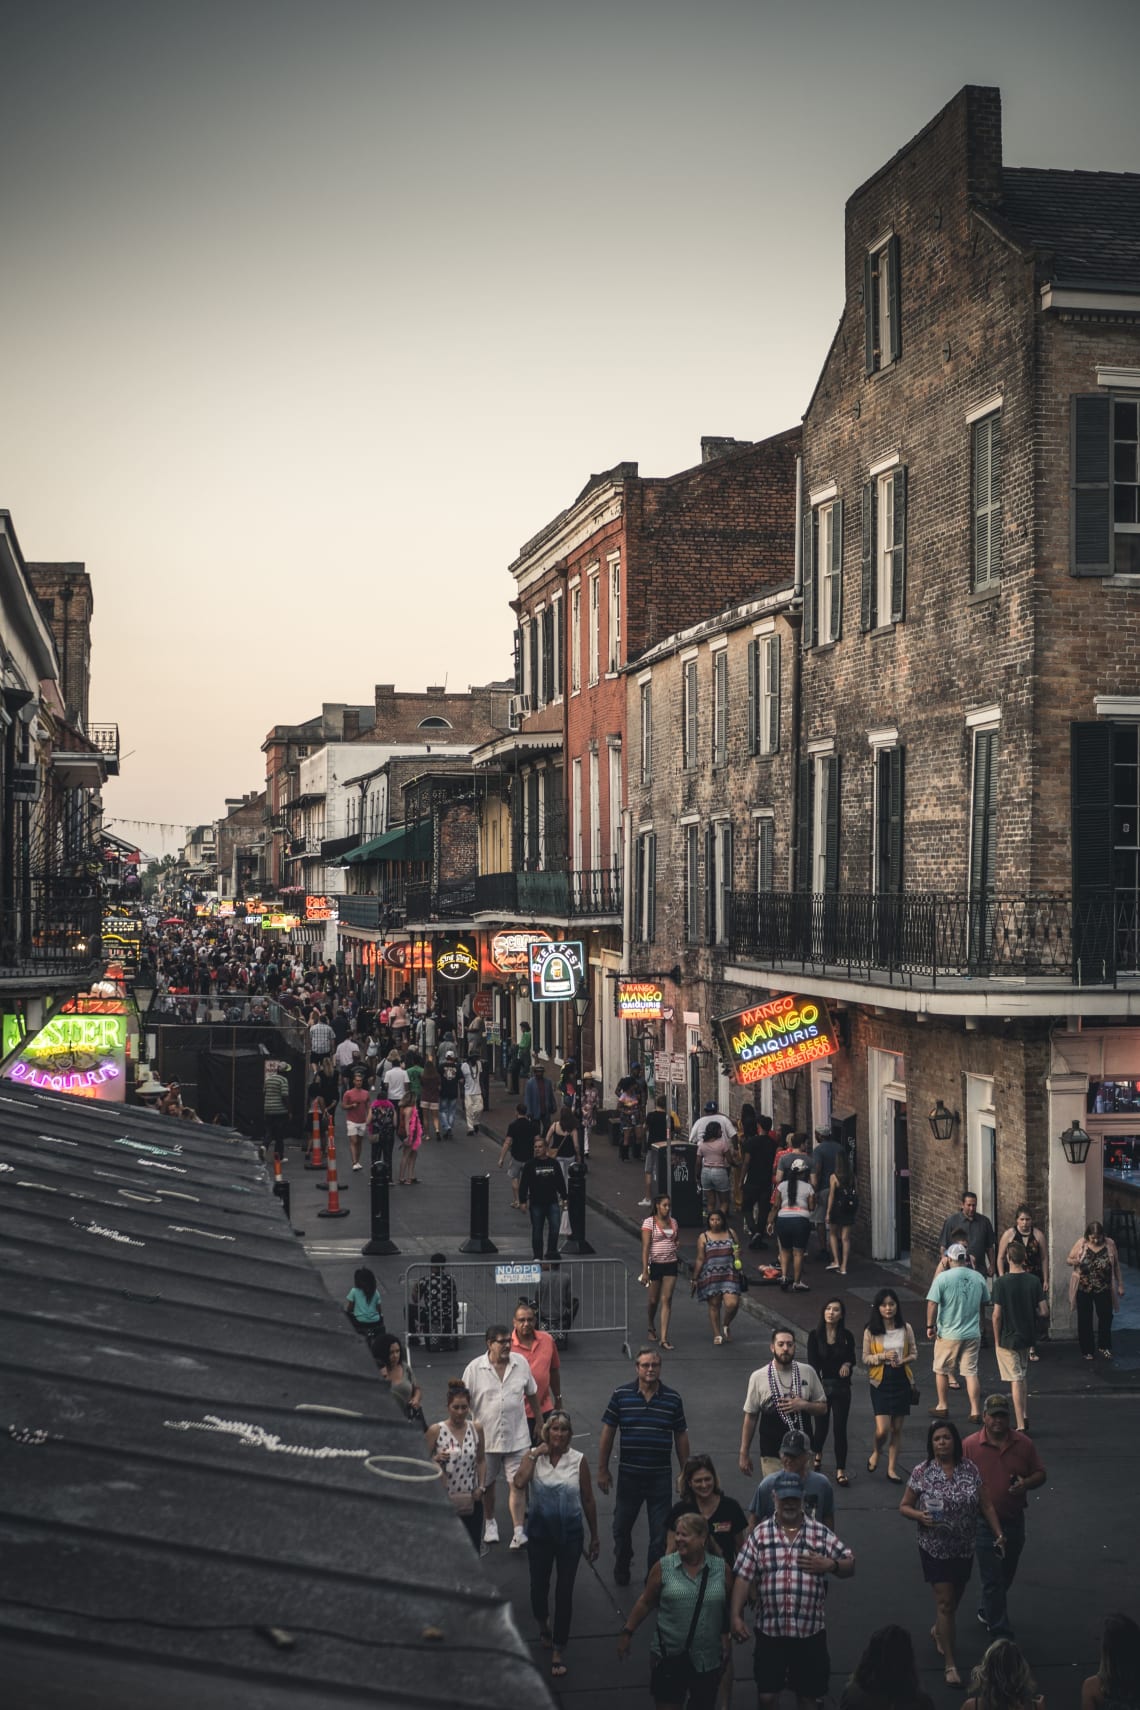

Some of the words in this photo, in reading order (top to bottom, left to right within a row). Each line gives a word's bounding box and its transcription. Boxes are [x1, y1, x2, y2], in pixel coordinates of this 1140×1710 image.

[306, 895, 326, 908] Fat
[532, 944, 556, 973] BEER
[559, 944, 583, 970] FEST
[620, 991, 662, 1003] MANGO
[626, 984, 656, 992] MANGO
[741, 998, 794, 1026] MANGO
[732, 1004, 819, 1054] MANGO
[741, 1025, 818, 1060] DAIQUIRIS
[36, 1044, 69, 1057] MARDI
[741, 1051, 783, 1073] COCKTAILS
[787, 1047, 795, 1057] &
[799, 1035, 829, 1052] BEER
[11, 1063, 119, 1091] DAIQUIRIS
